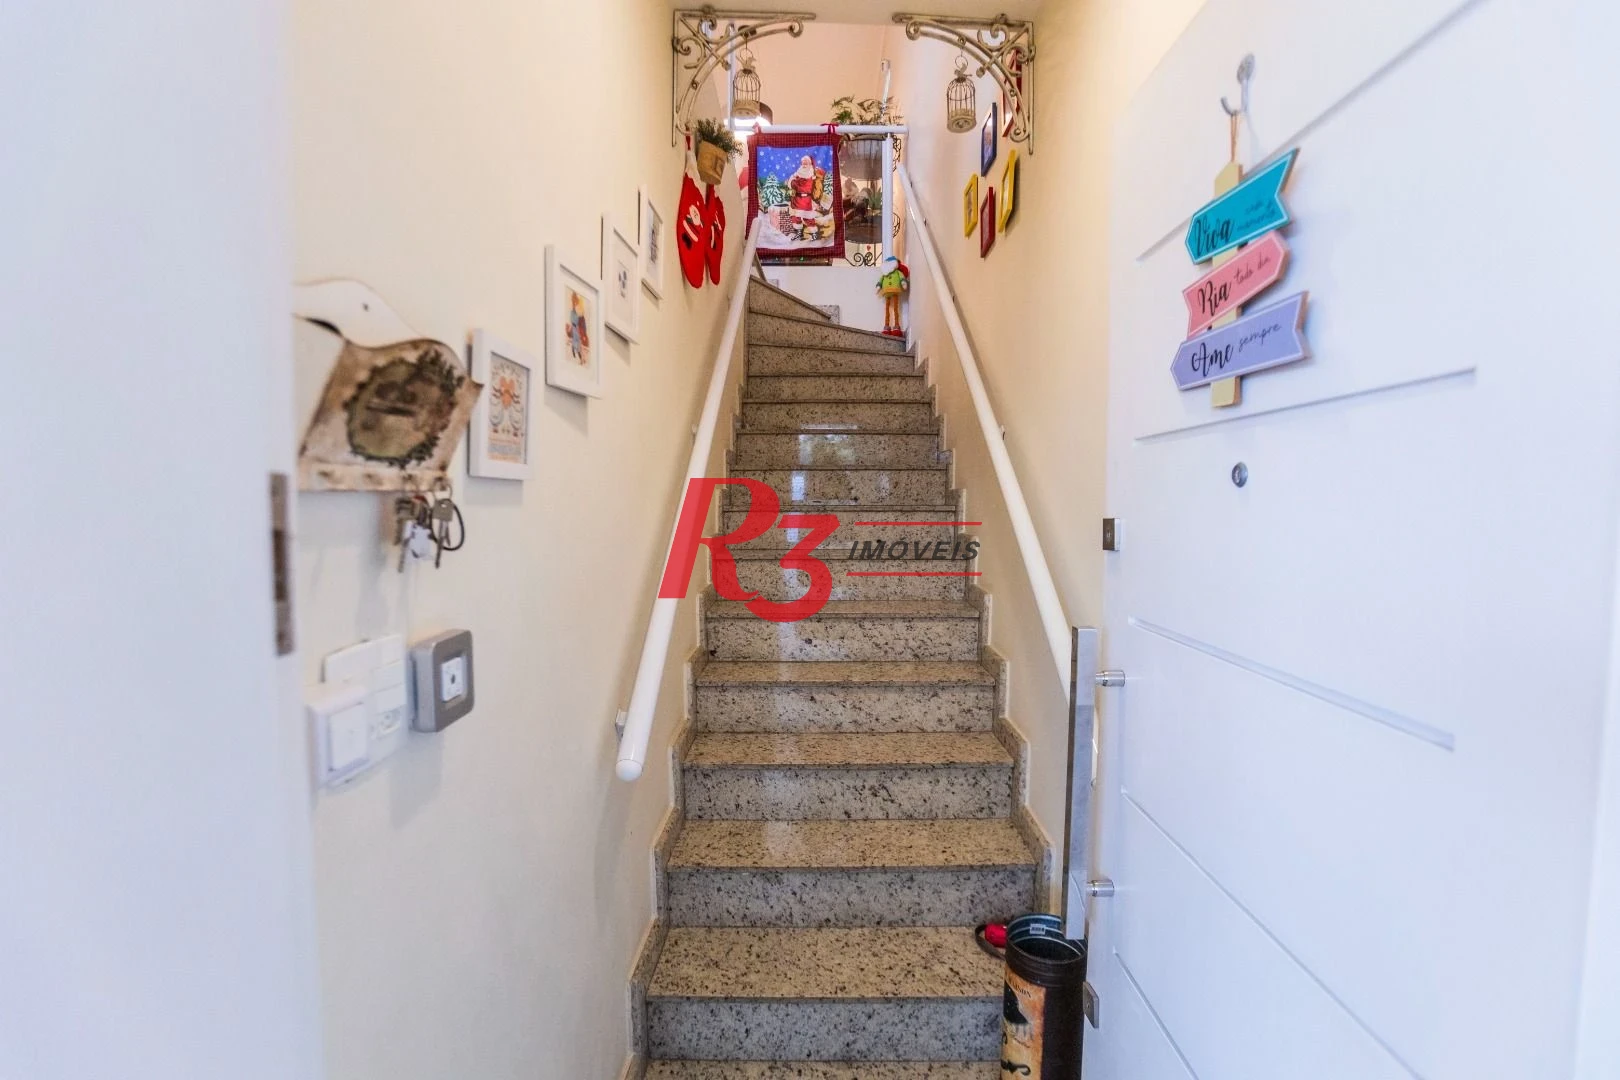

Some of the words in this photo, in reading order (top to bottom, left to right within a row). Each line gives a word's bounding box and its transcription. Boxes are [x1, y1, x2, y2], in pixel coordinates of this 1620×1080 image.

[1194, 214, 1235, 257] Viva
[1197, 280, 1232, 316] Ria
[1191, 342, 1234, 377] Ame
[1238, 323, 1281, 352] sempre
